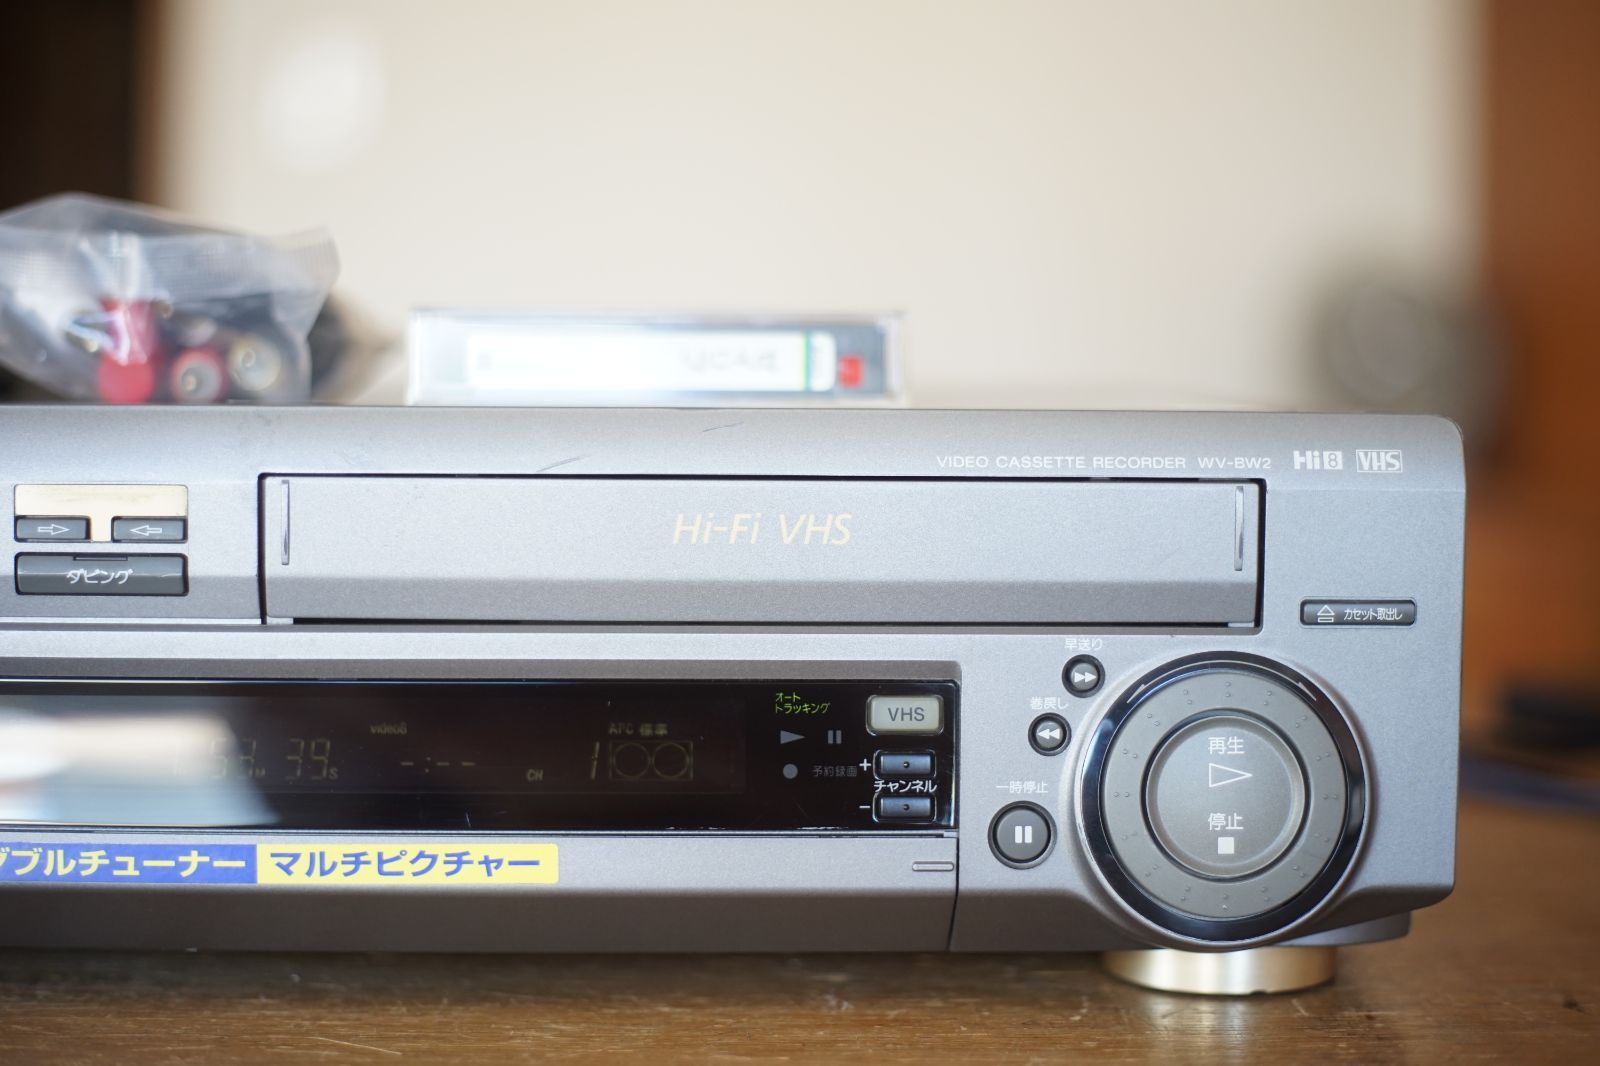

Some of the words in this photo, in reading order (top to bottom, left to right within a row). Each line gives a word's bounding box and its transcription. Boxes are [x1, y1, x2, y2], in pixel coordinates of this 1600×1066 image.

[936, 455, 989, 469] VIDEO
[995, 455, 1086, 470] CASSETTE
[1093, 456, 1187, 470] RECORDER
[1197, 456, 1272, 470] WV-BW2
[1357, 450, 1402, 472] VHS
[672, 512, 762, 545] Hi-Fi
[779, 512, 853, 545] VHS
[66, 568, 134, 585] ダビング
[1343, 607, 1403, 622] カセット取出し
[1064, 637, 1103, 651] 早送り
[775, 692, 801, 702] オート
[1030, 697, 1069, 710] 巻戻し
[775, 703, 830, 714] トラッキング
[887, 707, 925, 722] VHS
[1207, 737, 1245, 755] 再生
[874, 780, 937, 793] チャンネル
[996, 781, 1048, 795] 一時停止
[1207, 813, 1244, 831] 停止
[269, 850, 541, 879] マルチピクチャー
